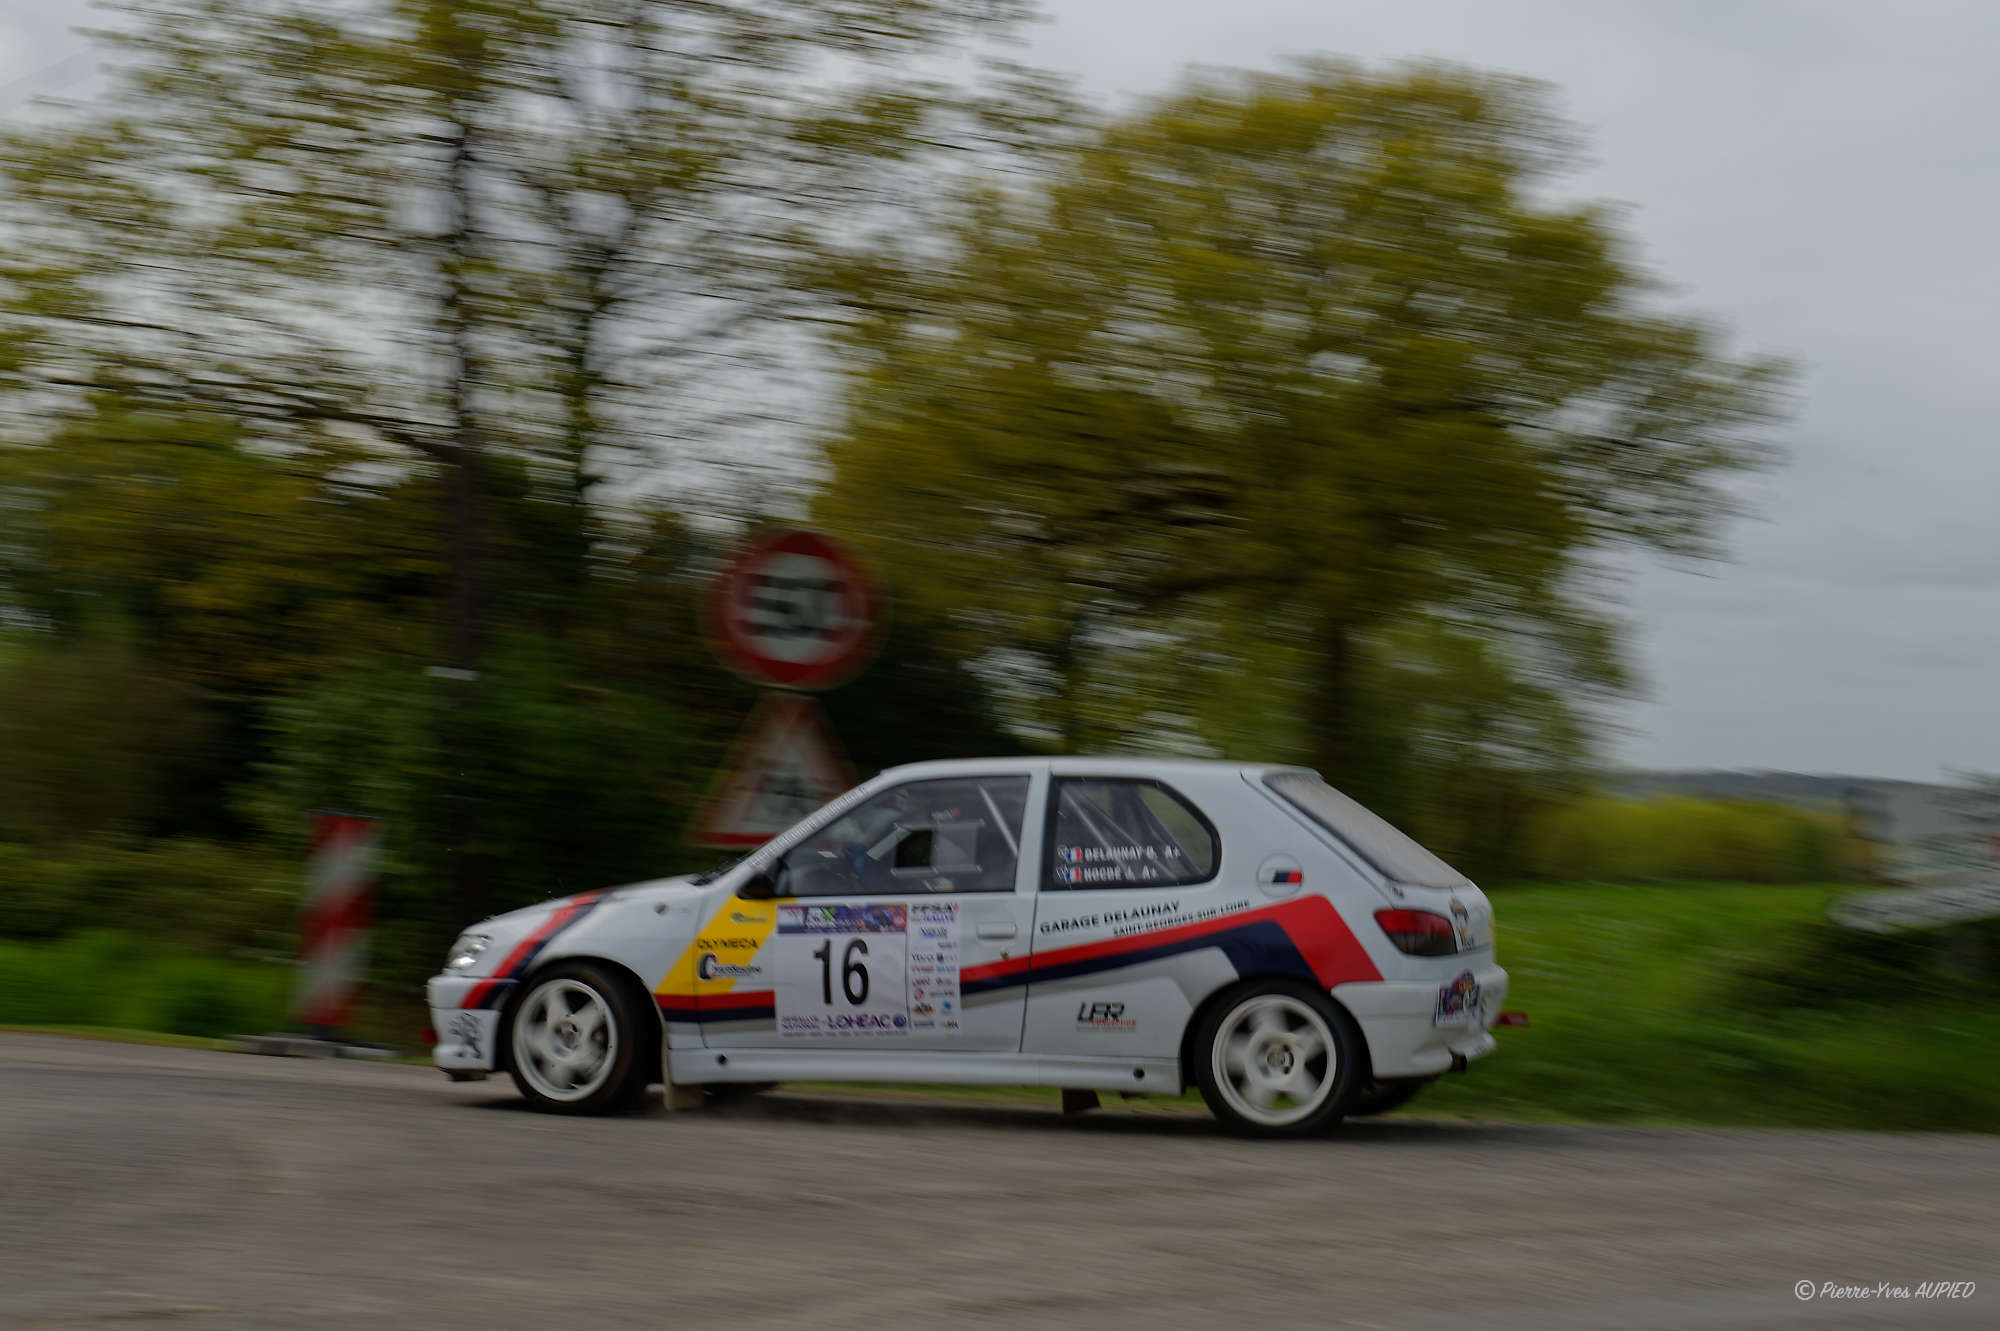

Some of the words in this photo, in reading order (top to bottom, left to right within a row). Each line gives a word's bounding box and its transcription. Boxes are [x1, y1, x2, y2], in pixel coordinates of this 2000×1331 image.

[1084, 846, 1142, 862] DELAUNAY
[1040, 911, 1100, 936] GARAGE
[1103, 900, 1180, 925] DELAUNAY
[814, 937, 870, 1006] 16
